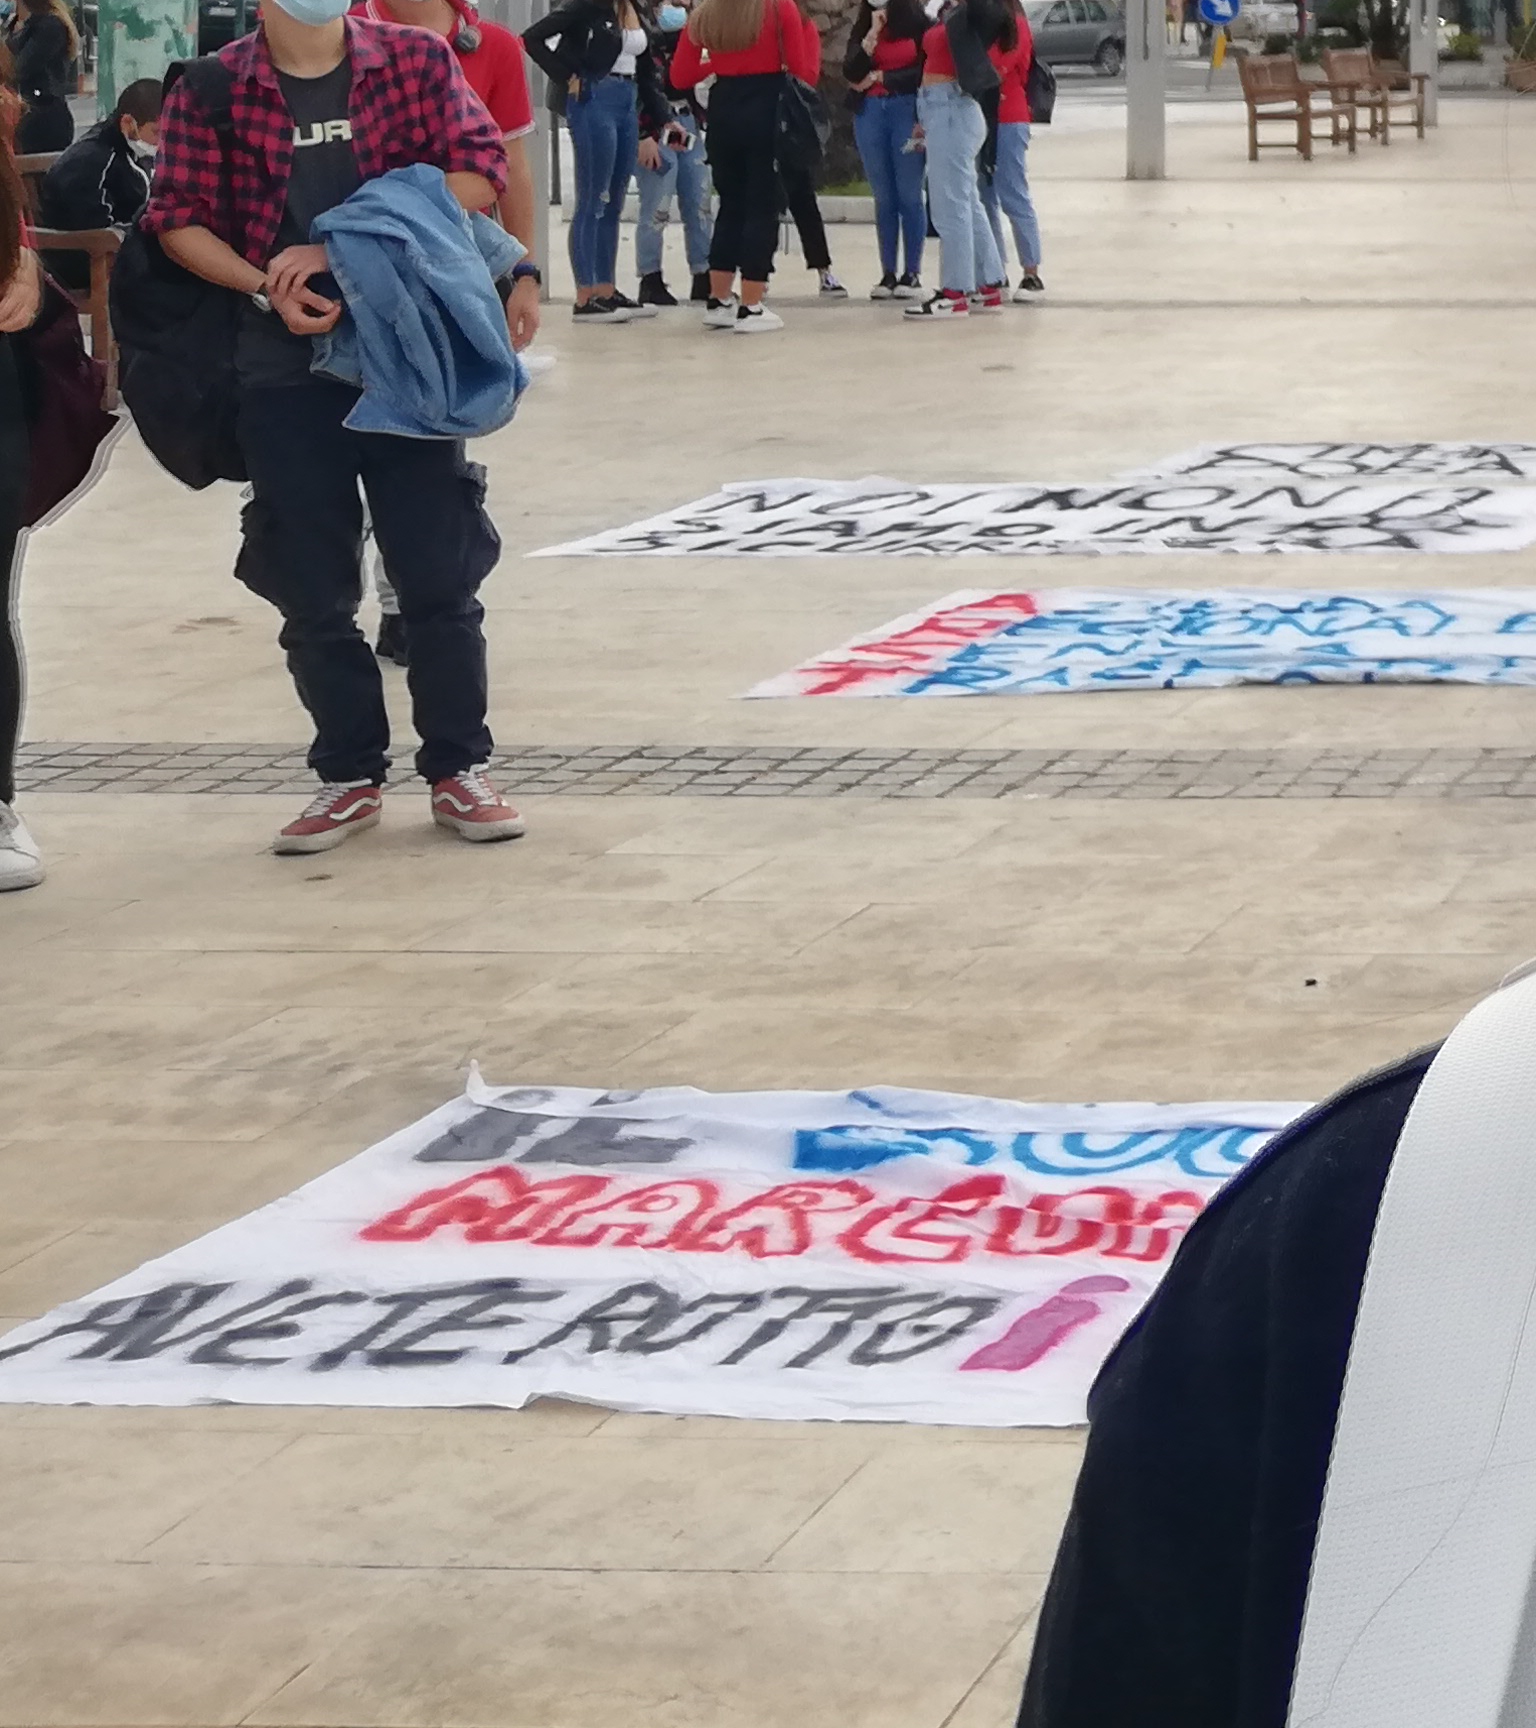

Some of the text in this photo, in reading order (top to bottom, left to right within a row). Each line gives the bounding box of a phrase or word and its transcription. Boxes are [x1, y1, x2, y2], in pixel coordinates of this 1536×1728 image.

[695, 485, 1362, 516] NOI NON
[672, 517, 1056, 537] SIAMO
[0, 1278, 567, 1372] AVETE
[502, 1280, 1001, 1370] ROTTO
